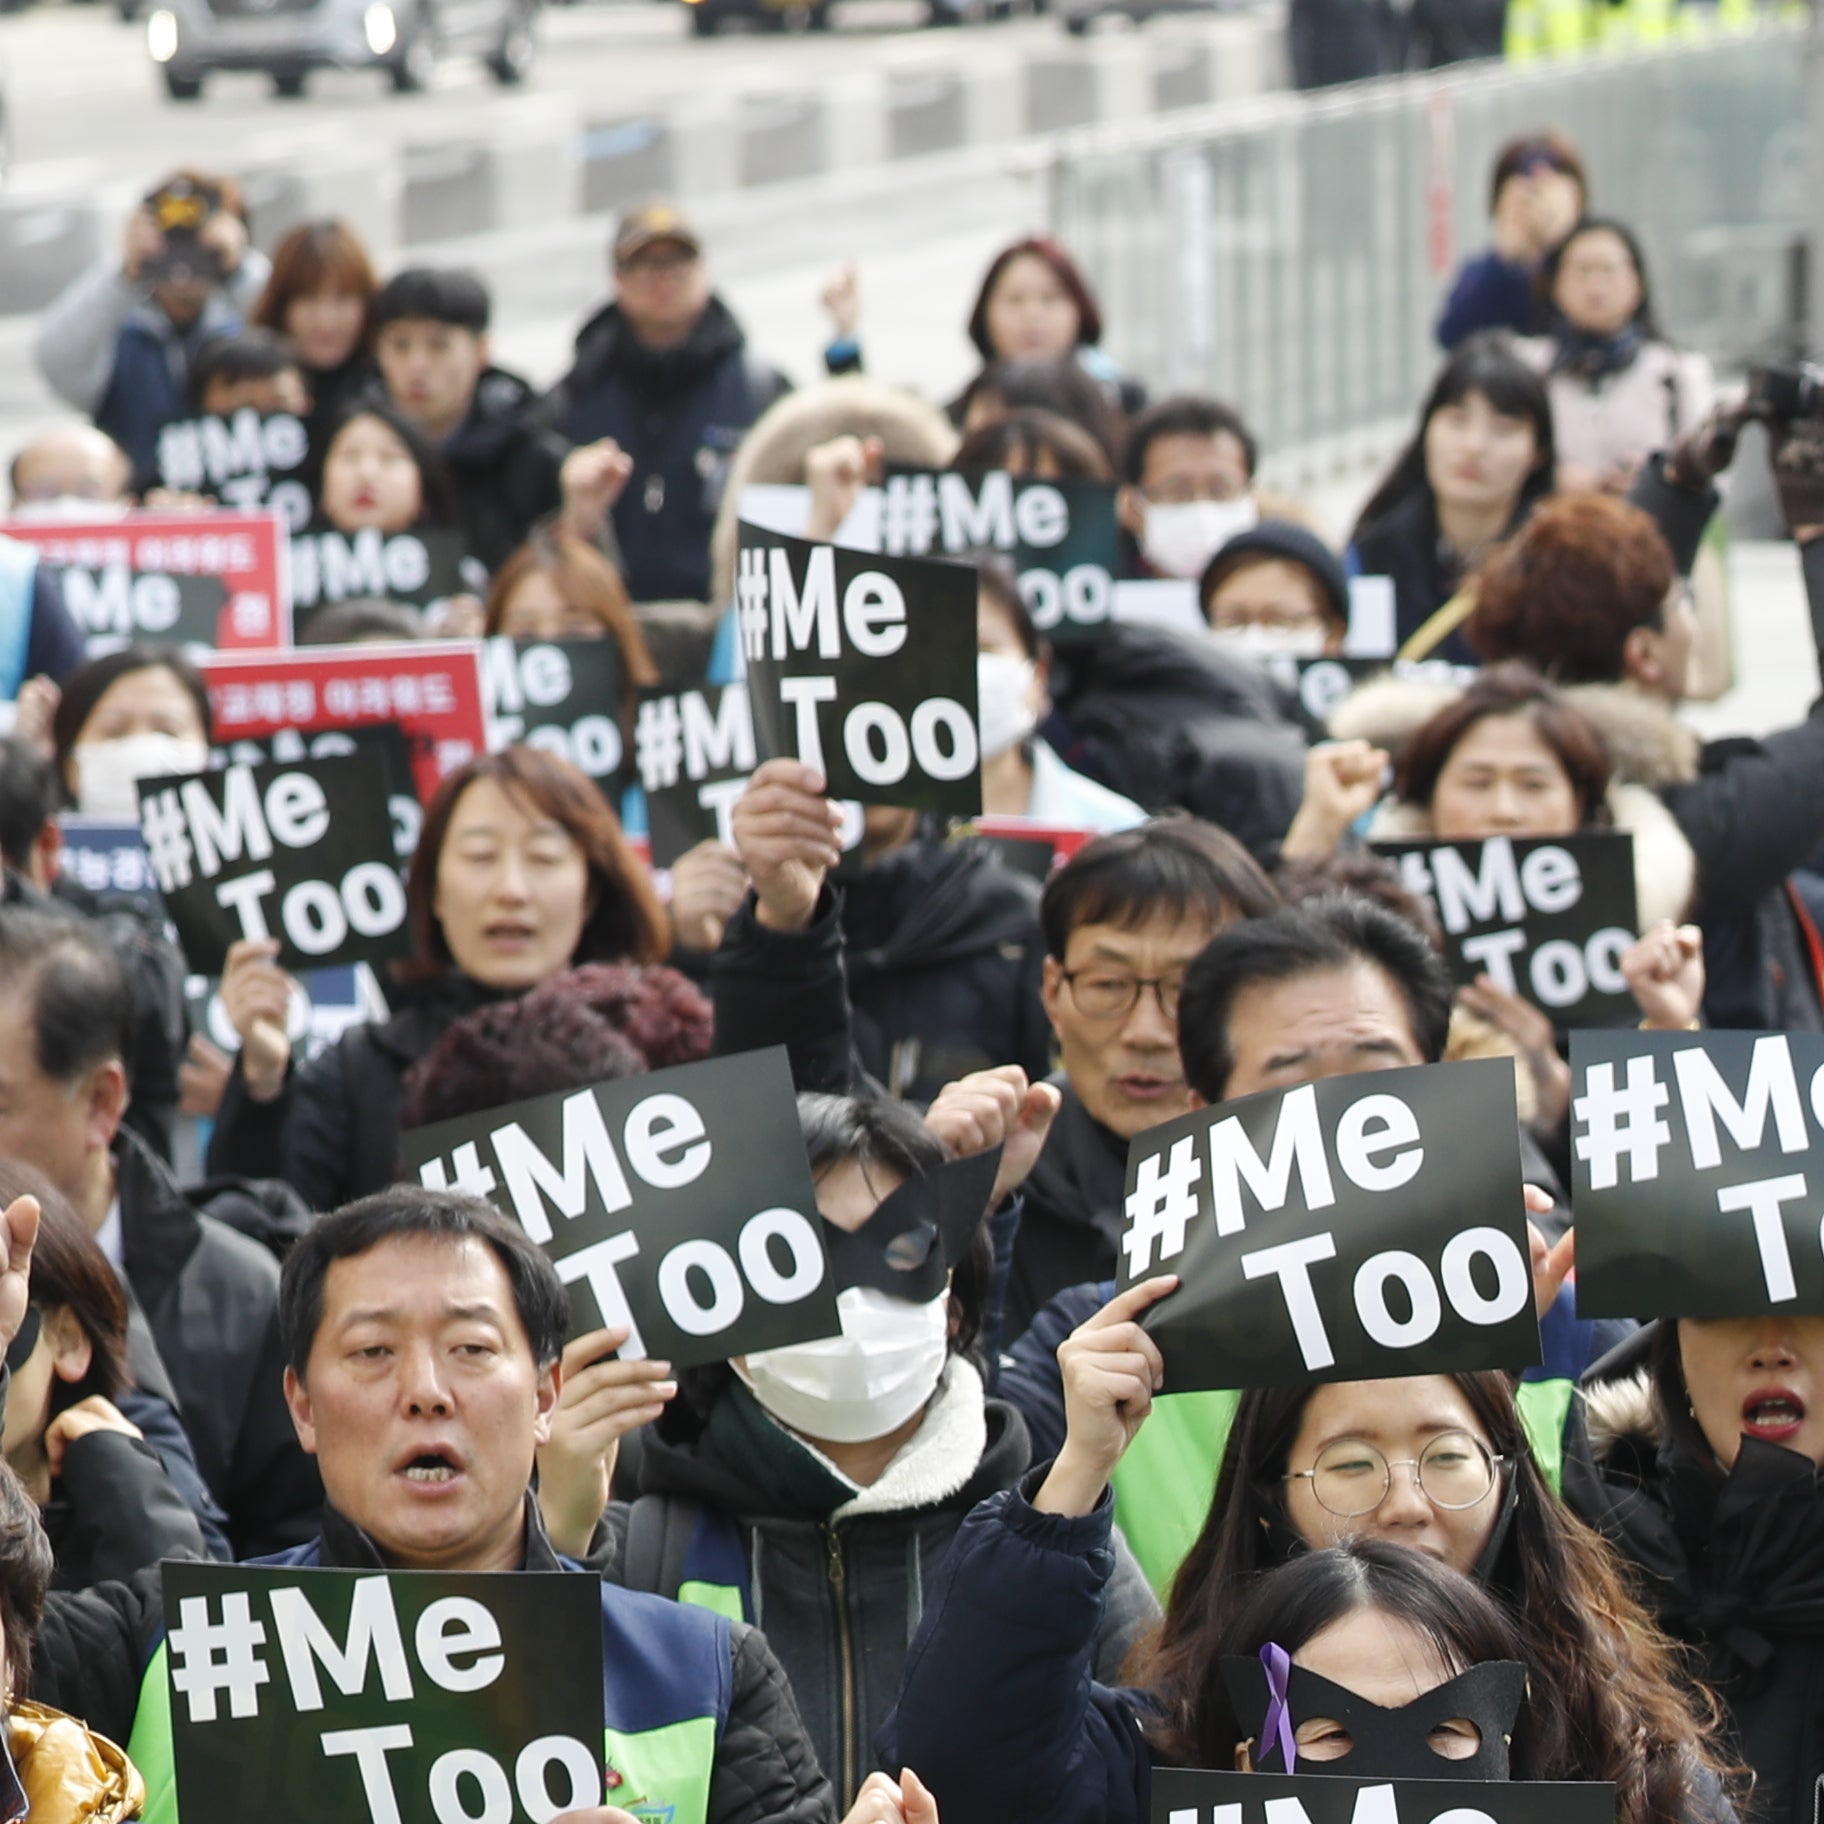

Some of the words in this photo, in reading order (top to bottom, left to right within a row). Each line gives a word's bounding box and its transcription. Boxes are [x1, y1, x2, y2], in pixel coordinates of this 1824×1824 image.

[879, 471, 1069, 553] #Me
[62, 565, 182, 635] Me
[737, 546, 908, 661] #Me
[484, 639, 572, 713] Me
[781, 676, 980, 791] Too
[634, 682, 757, 792] #M
[142, 766, 330, 893] #Me
[217, 861, 407, 955] Too
[419, 1089, 712, 1246] #Me
[1122, 1083, 1426, 1279] #Me
[557, 1206, 826, 1362] Too
[1241, 1224, 1529, 1373] Too
[169, 1575, 506, 1724] #Me
